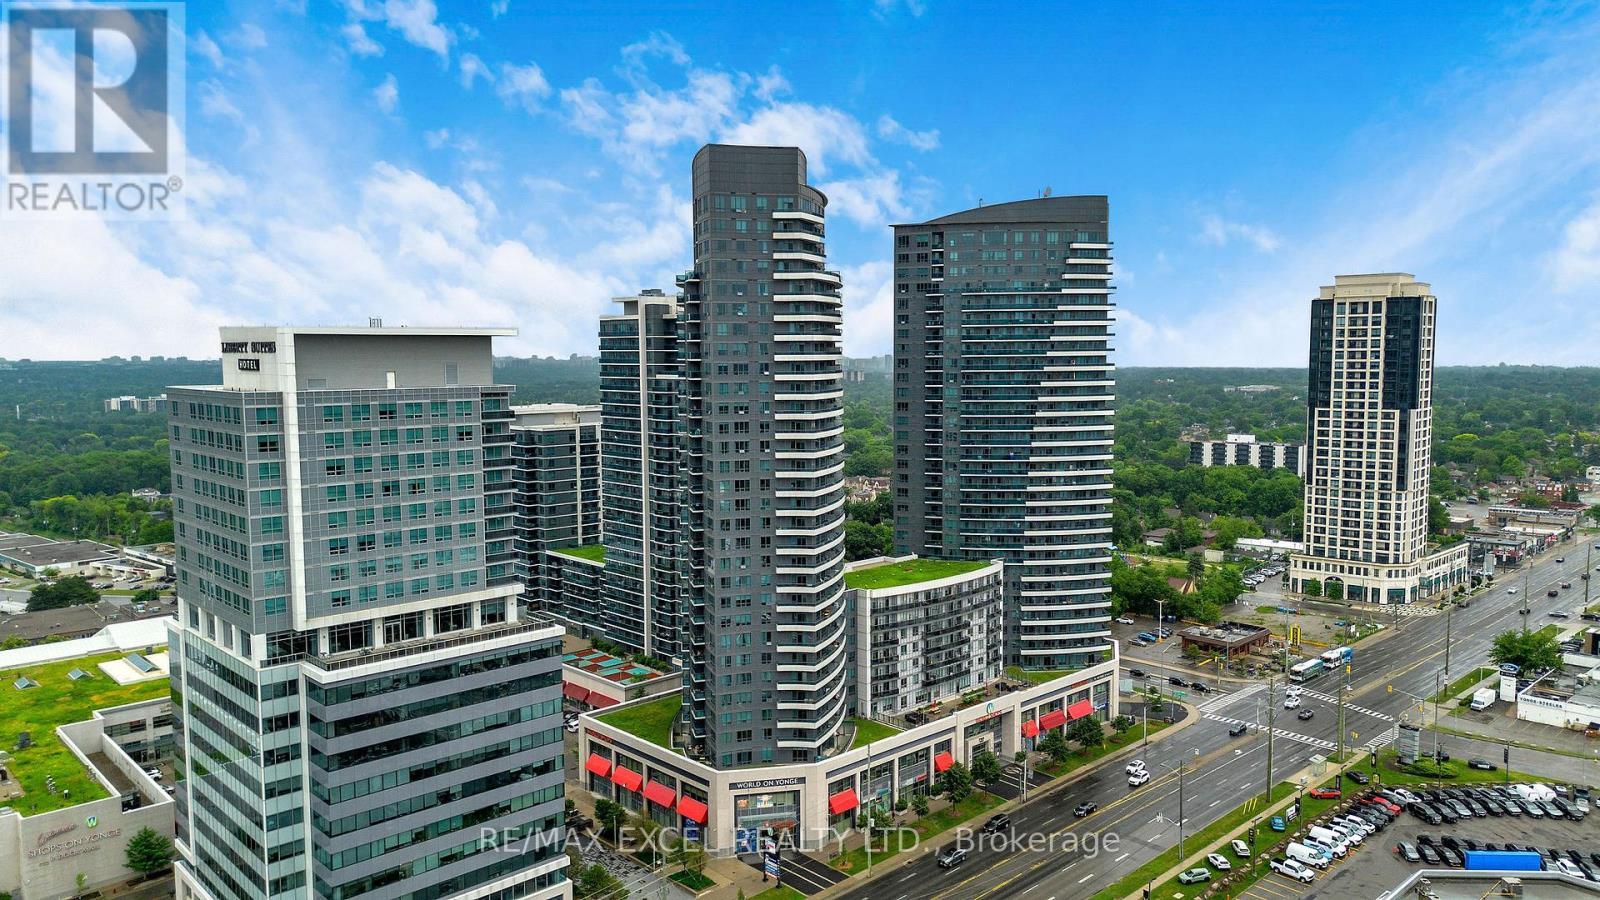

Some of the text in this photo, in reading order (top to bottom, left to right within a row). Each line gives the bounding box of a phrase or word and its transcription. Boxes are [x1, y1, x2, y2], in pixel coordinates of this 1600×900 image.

[239, 360, 257, 370] HOTEL
[27, 844, 62, 859] SHOPS
[64, 838, 83, 849] ON
[85, 827, 121, 843] YONGE
